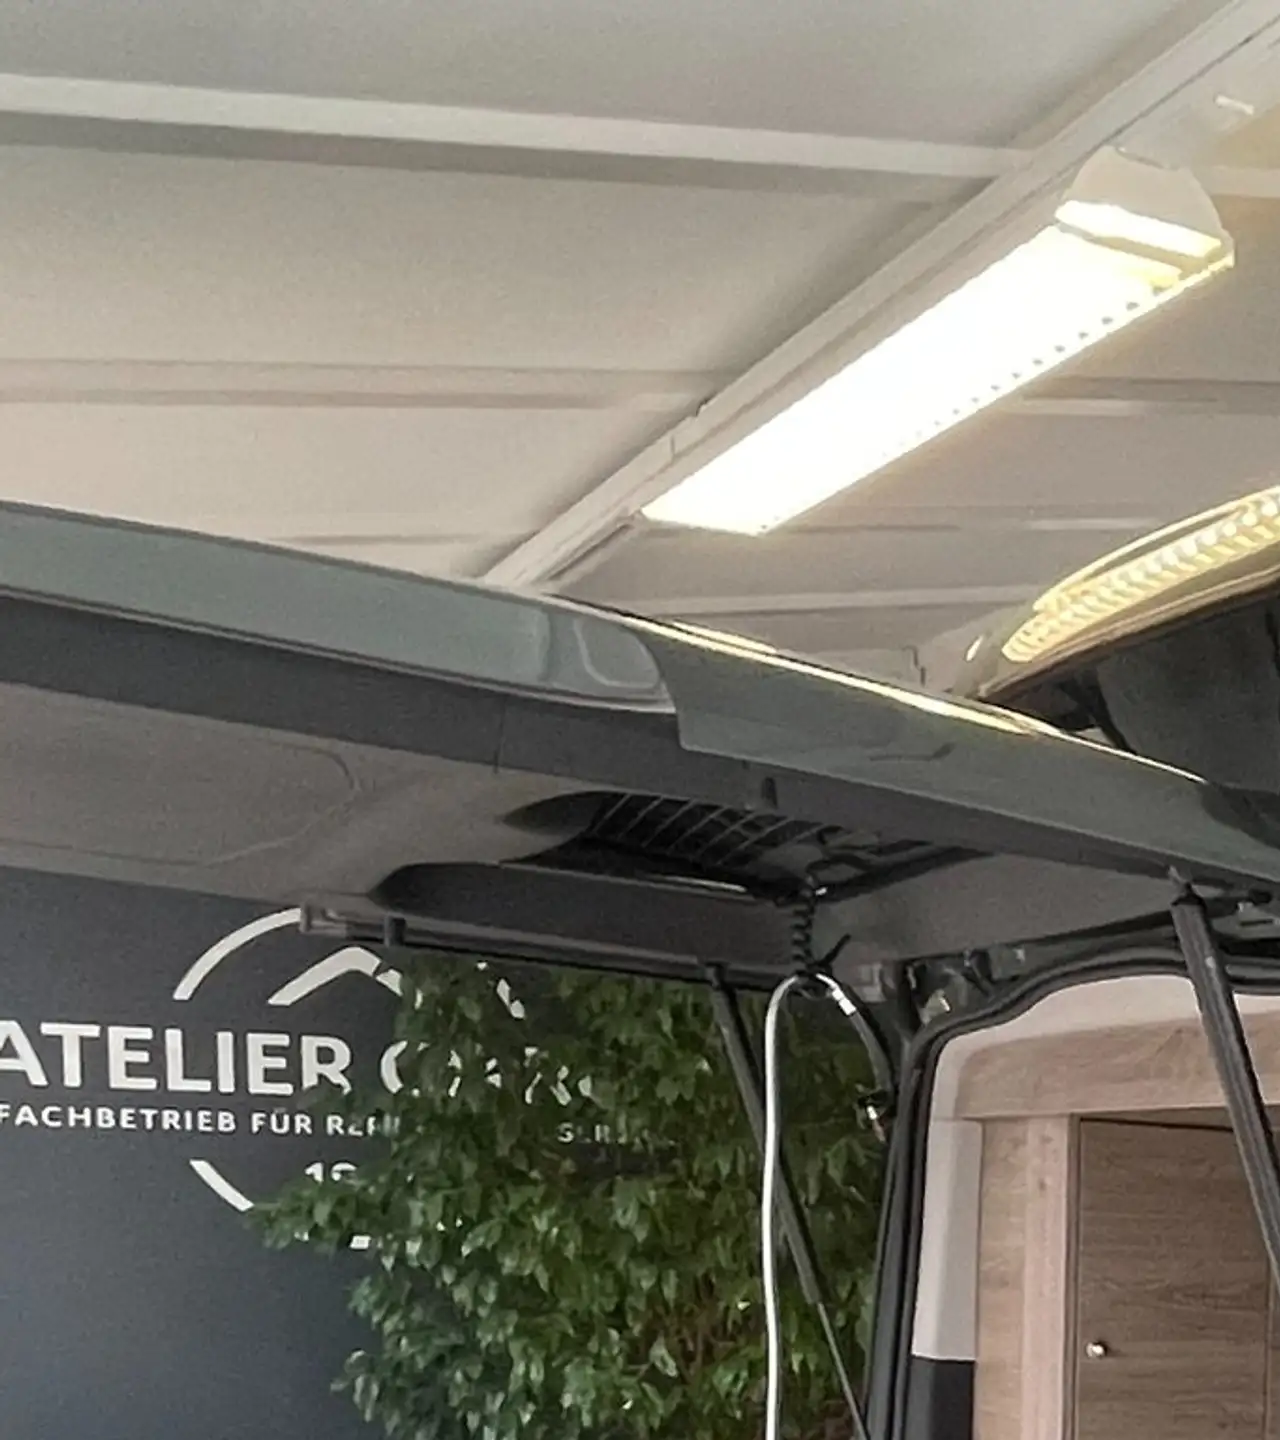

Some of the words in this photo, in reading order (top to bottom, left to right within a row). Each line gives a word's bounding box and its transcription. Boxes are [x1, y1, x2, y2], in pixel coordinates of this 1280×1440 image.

[0, 1020, 353, 1096] ATELIER
[0, 1102, 236, 1133] FACHBETRIEB
[251, 1108, 313, 1136] FÜR
